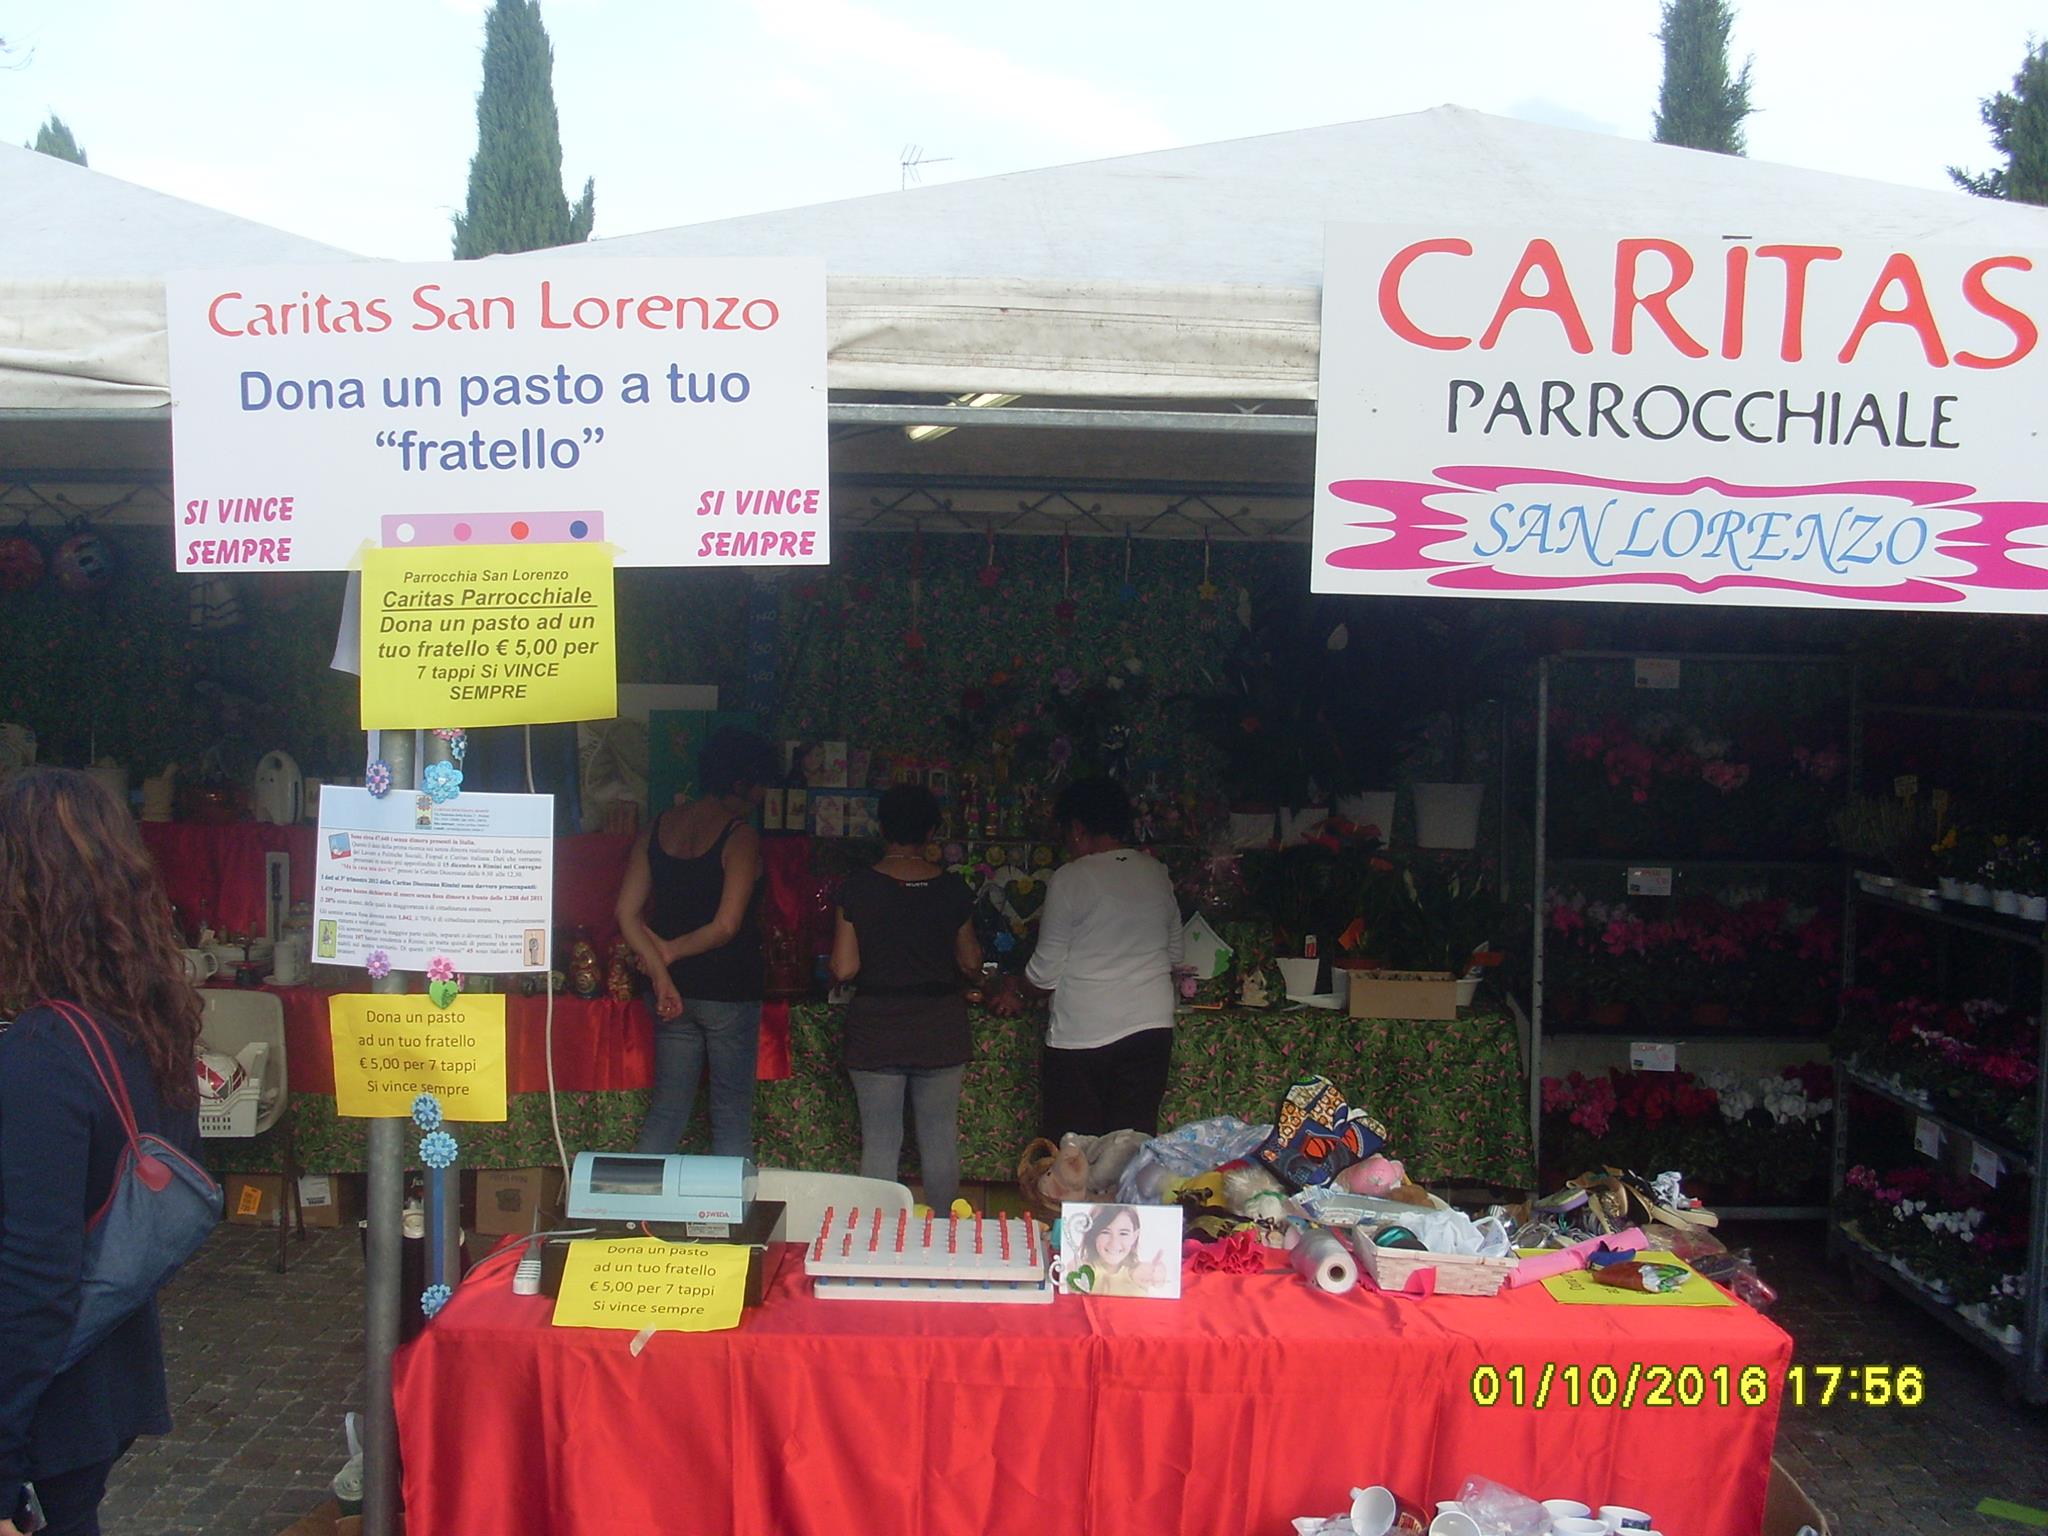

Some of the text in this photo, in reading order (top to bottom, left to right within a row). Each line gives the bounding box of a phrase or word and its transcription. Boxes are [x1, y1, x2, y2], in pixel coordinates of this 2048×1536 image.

[208, 281, 780, 338] Caritas San Lorenzo
[1378, 238, 2039, 370] CARITAS
[240, 362, 751, 416] Dona un pasto a tuo
[1447, 379, 1961, 449] PARROCCHIALE
[184, 495, 295, 526] SI VINCE
[696, 487, 820, 517] SI VINCE
[697, 530, 816, 558] SEMPRE
[1473, 499, 1928, 573] SAN LORENZO
[186, 537, 292, 566] SEMPRE
[404, 569, 569, 584] Parrocchia San Lorenzo
[383, 587, 592, 608] Caritas Parrocchiale
[380, 613, 596, 635] Dona un pasto ad un
[378, 638, 599, 659] tuo fratello € 5,00 per
[418, 662, 559, 682] 7 tappi Si VINCE
[450, 685, 527, 700] SEMPRE
[366, 1010, 466, 1026] Dona un pasto
[358, 1034, 476, 1048] ad un tuo fratello
[360, 1057, 476, 1076] € 5,00 per 7 tappi
[368, 1080, 470, 1097] Si vince sempre
[608, 1245, 709, 1257] Dona un pasto
[594, 1262, 716, 1276] ad un tuo fratello
[590, 1280, 716, 1296] € 5,00 per 7 tappi
[592, 1301, 704, 1316] Si vince sempre
